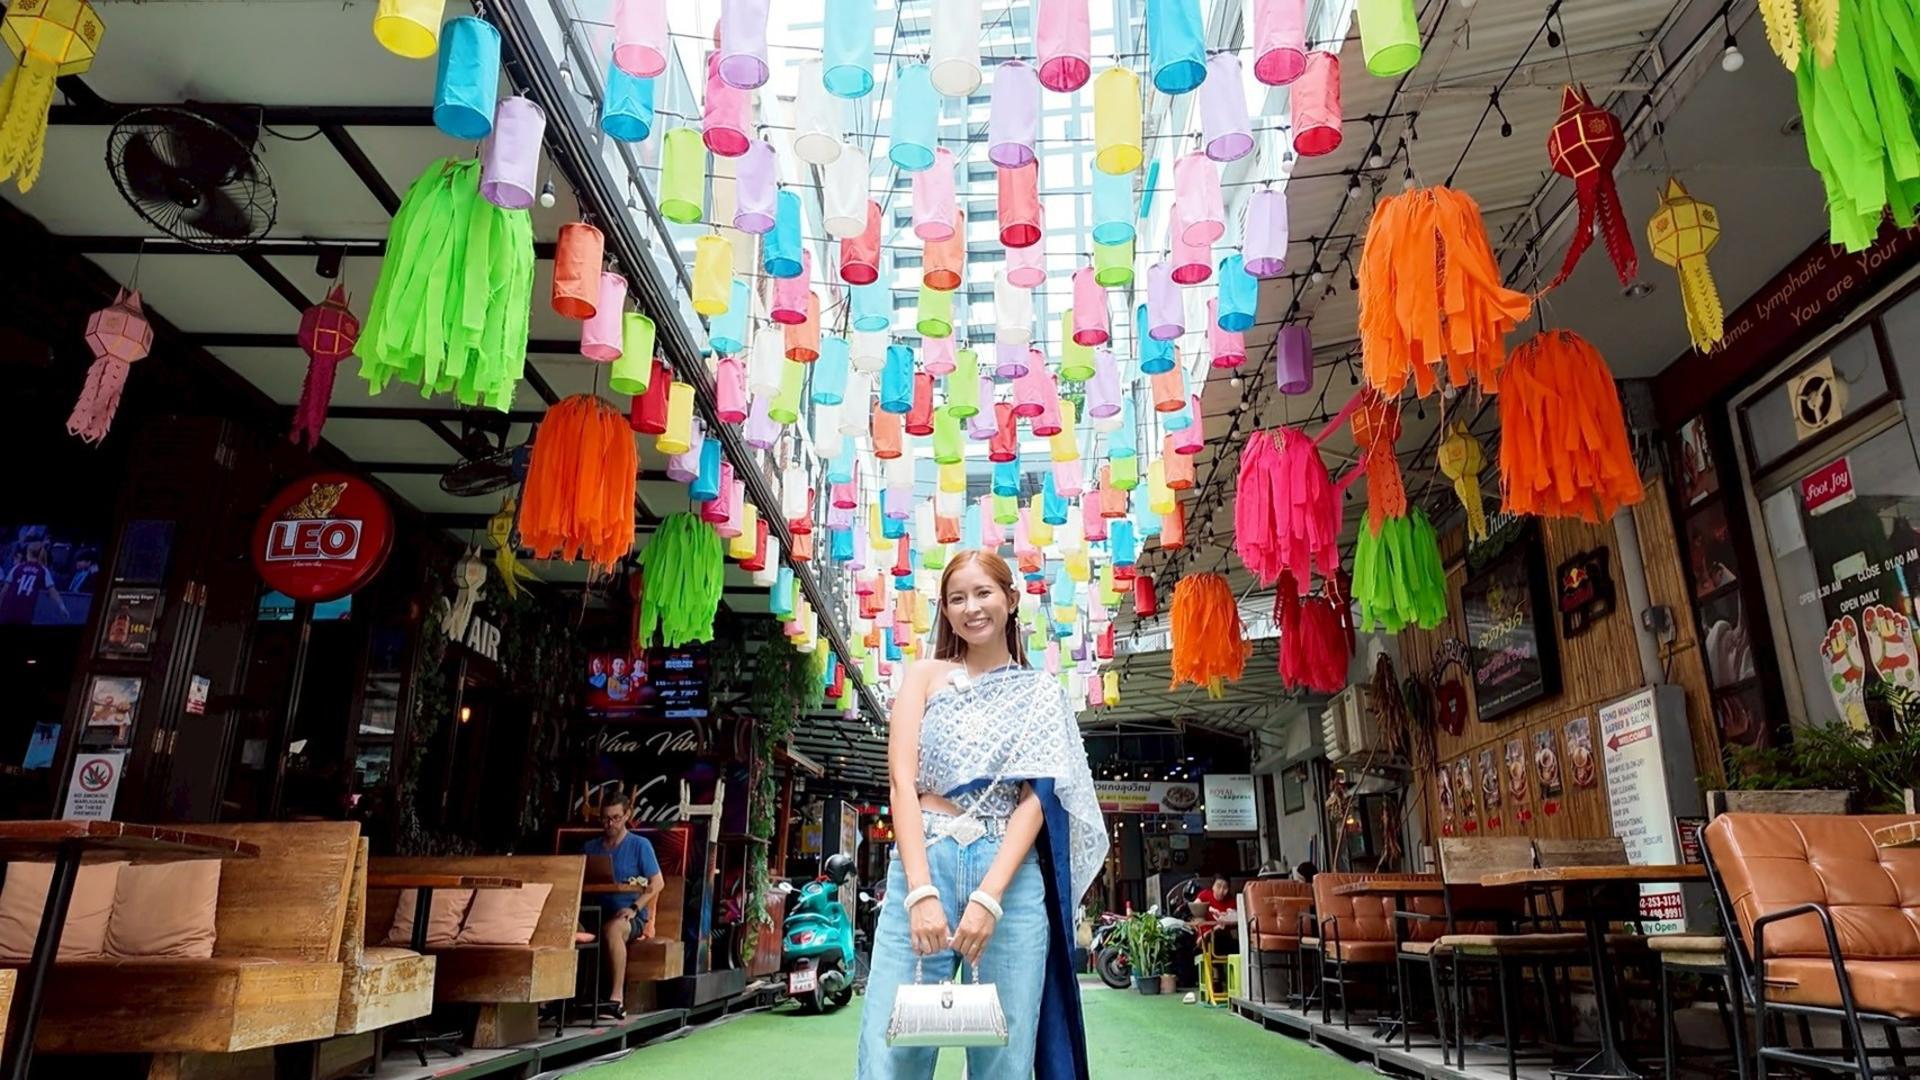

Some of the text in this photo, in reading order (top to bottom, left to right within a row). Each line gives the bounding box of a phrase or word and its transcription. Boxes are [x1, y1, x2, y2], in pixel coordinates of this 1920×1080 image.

[1756, 255, 1827, 322] Lymphatic
[1791, 299, 1821, 328] You
[1827, 275, 1854, 303] are
[1856, 239, 1897, 275] Your
[1830, 471, 1848, 494] Joy
[268, 520, 360, 560] LEO
[1831, 580, 1843, 593] AM
[1857, 564, 1881, 582] CLOSE
[1906, 548, 1920, 563] AM
[17, 574, 37, 597] 14
[1840, 588, 1881, 613] OPEN DAILY
[467, 615, 501, 662] AIR
[1617, 697, 1652, 716] MANHATTAN
[1605, 720, 1624, 735] BARBER
[1630, 710, 1650, 726] SALON
[1618, 730, 1647, 744] WELCOME
[1654, 922, 1678, 932] Open
